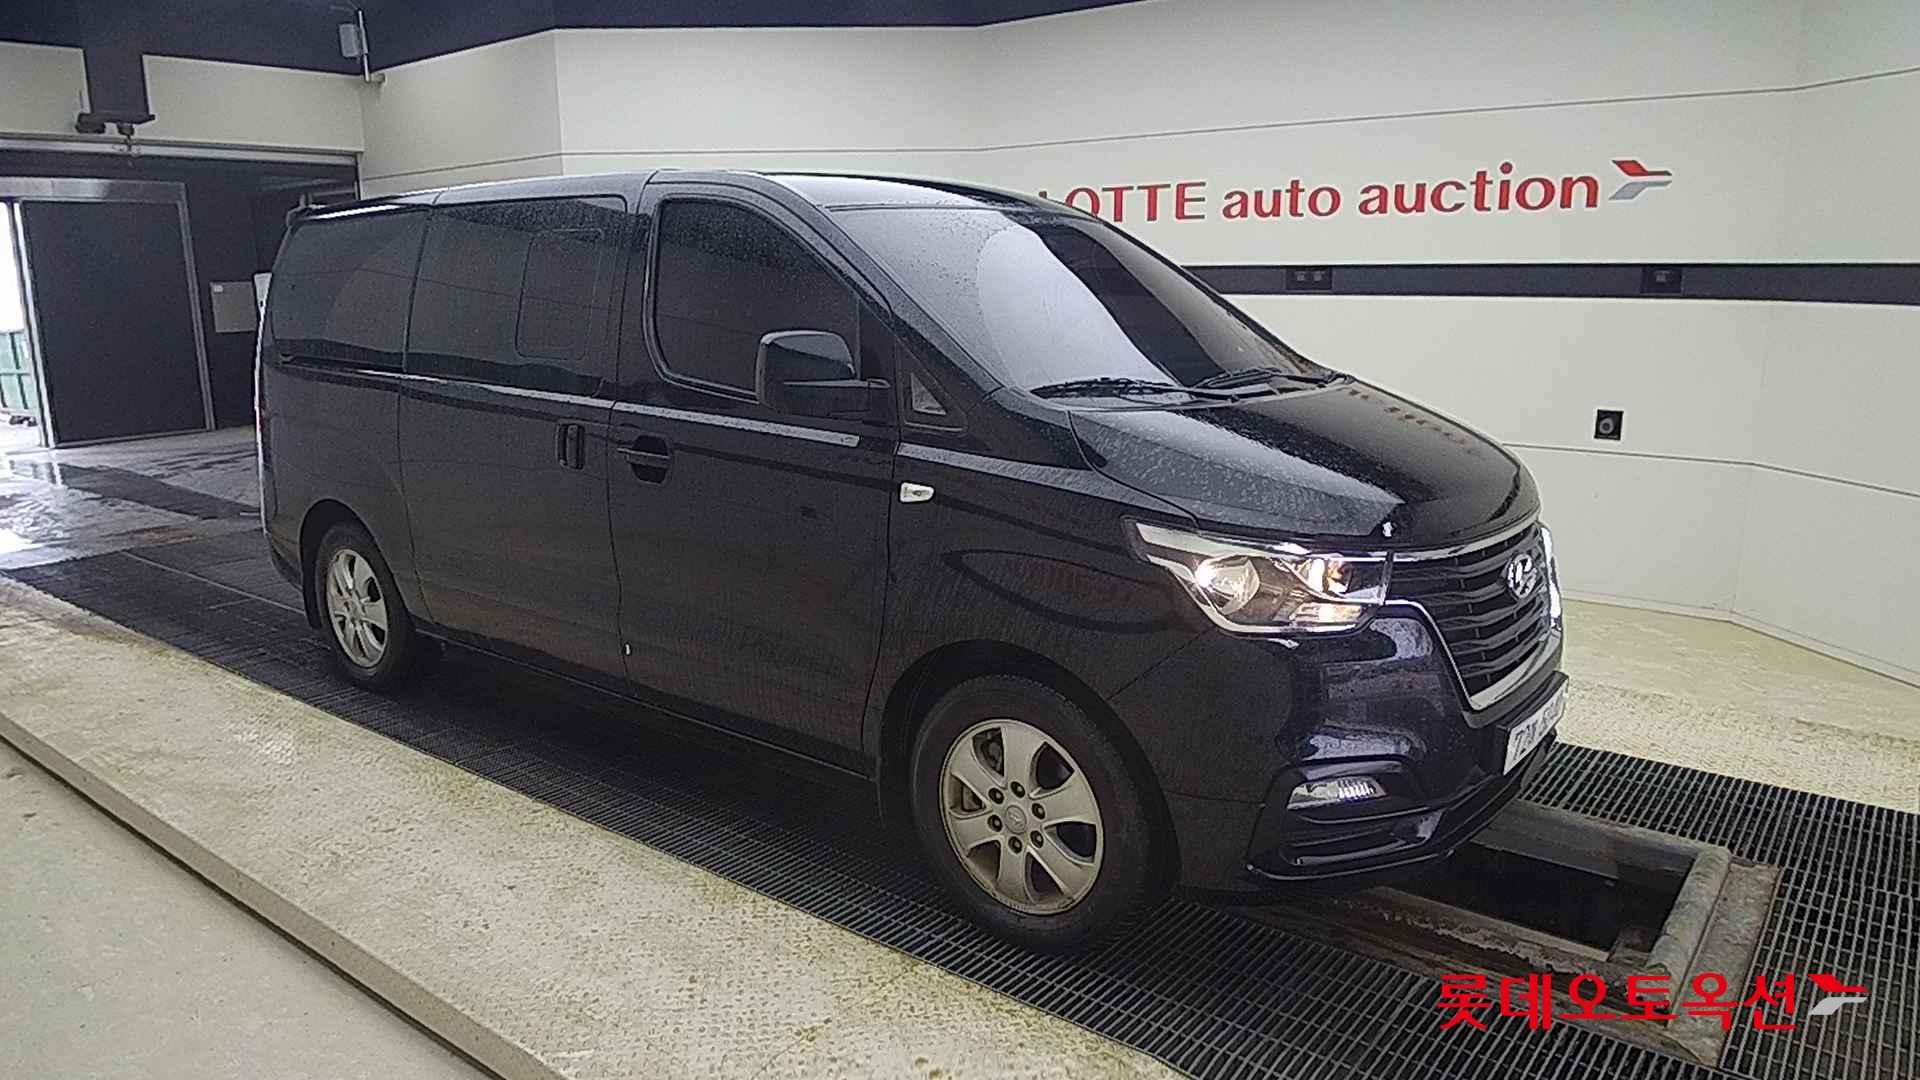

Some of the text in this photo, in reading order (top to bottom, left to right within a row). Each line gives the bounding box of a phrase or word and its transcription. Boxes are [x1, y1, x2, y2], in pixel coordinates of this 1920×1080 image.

[1038, 162, 1599, 222] OTTE auto auction
